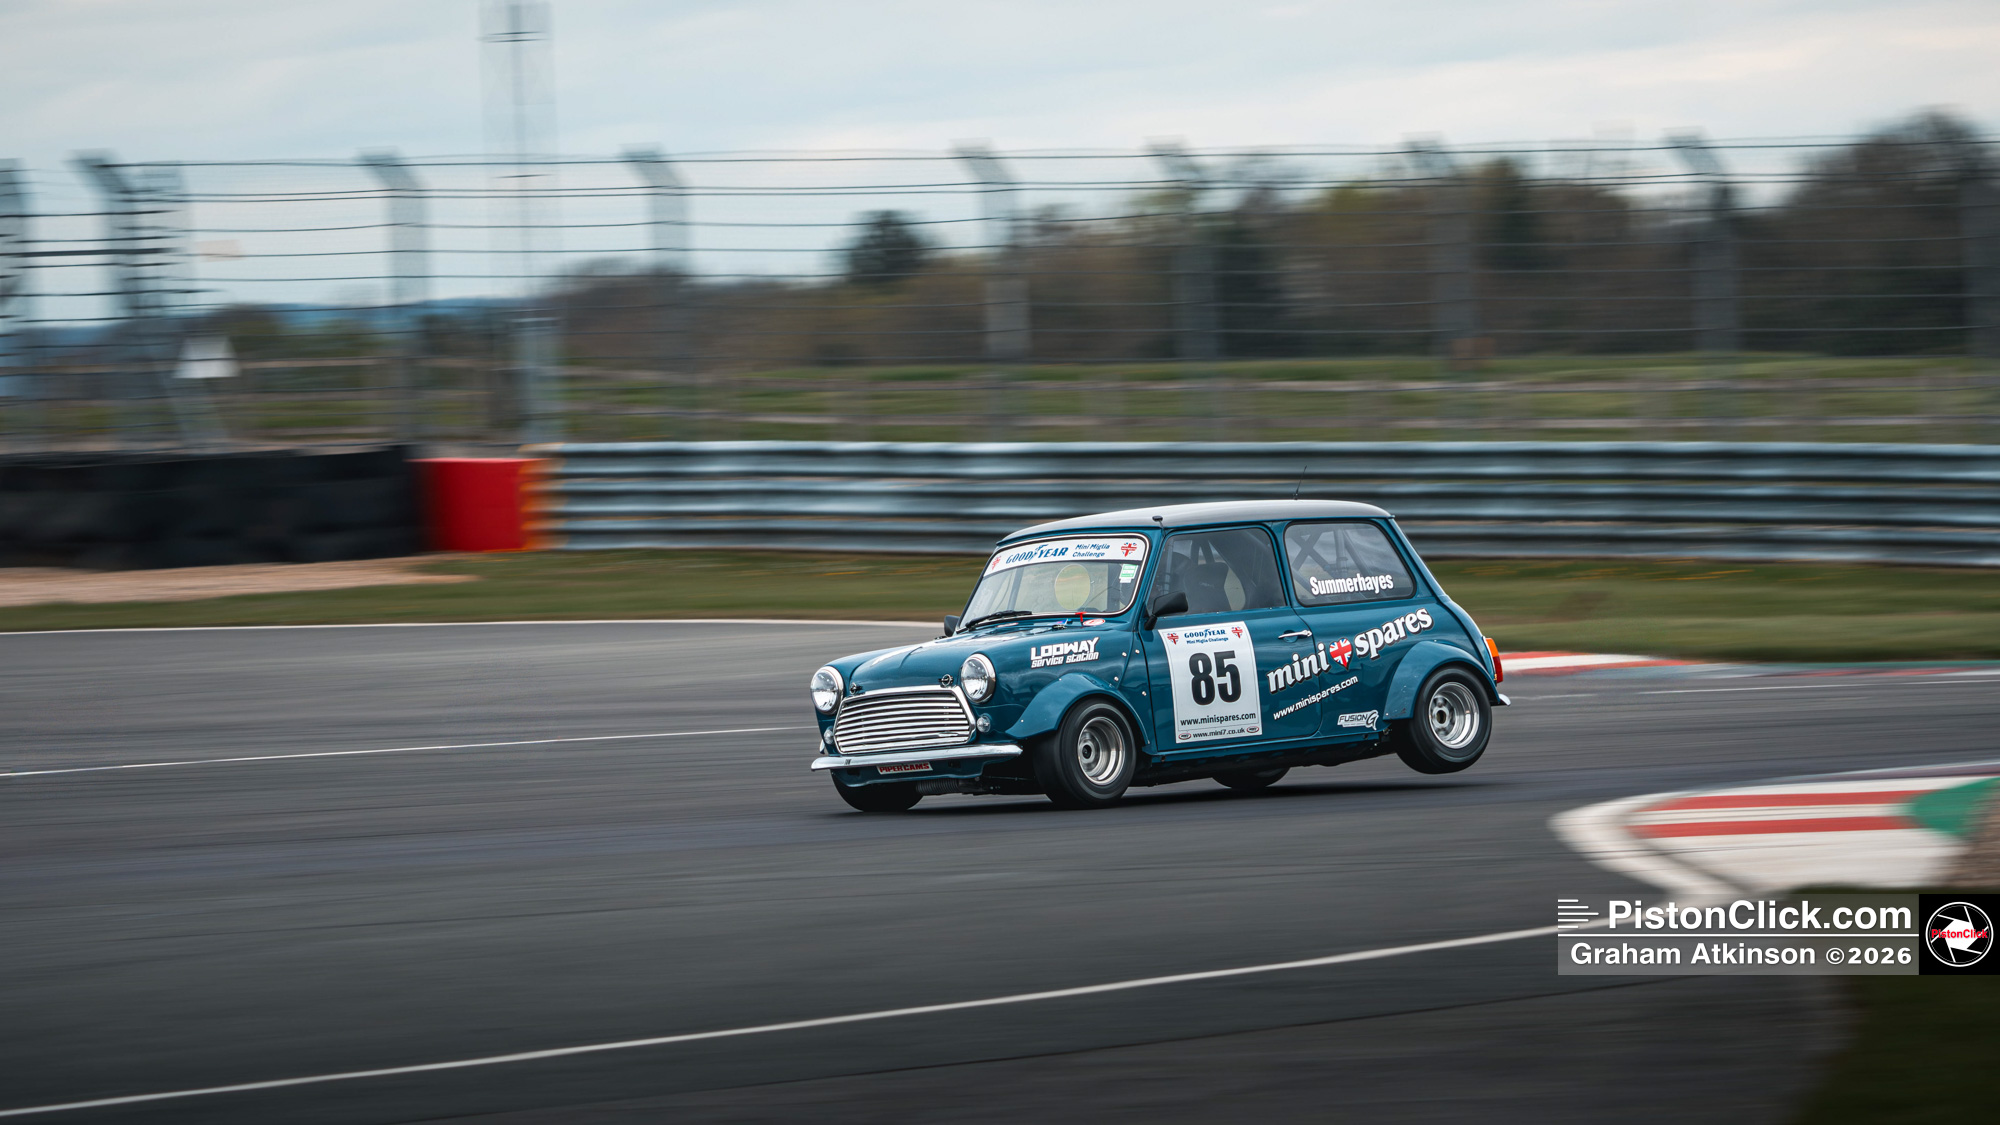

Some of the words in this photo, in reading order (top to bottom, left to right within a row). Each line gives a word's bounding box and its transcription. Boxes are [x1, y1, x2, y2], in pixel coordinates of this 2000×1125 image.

[1005, 544, 1069, 564] GOODYEAR
[1091, 543, 1110, 551] Miglia
[1309, 573, 1394, 596] Summerhayes
[1184, 629, 1226, 638] GOODYEAR
[1031, 655, 1064, 668] service
[1065, 651, 1099, 664] station
[1266, 642, 1331, 694] mini
[1354, 608, 1434, 660] spares
[1189, 650, 1241, 706] 85
[1273, 675, 1359, 720] www.minispares.com
[1180, 712, 1256, 726] www.minispares.com
[1192, 727, 1245, 738] www.mini7.co.uk
[879, 765, 903, 773] PIPER
[903, 762, 930, 772] CAMS
